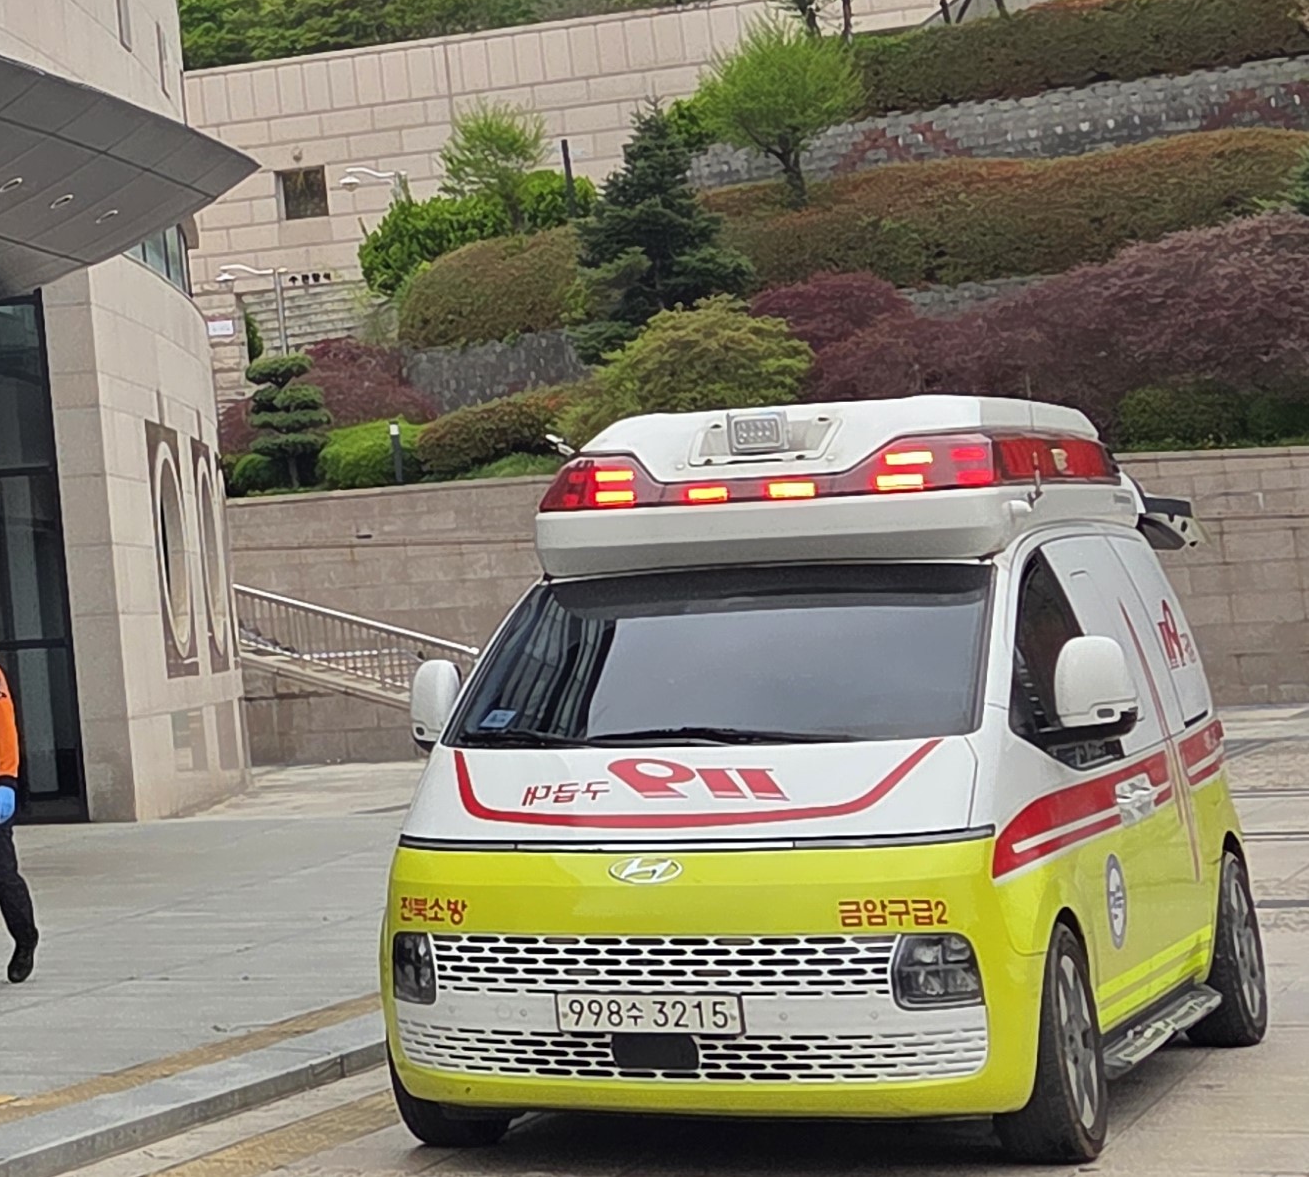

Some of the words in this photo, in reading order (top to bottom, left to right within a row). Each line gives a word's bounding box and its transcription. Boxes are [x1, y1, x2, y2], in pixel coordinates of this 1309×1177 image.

[400, 897, 468, 925] 전북소방
[838, 899, 948, 927] 금암구급2
[568, 999, 644, 1027] 998수
[652, 1000, 728, 1029] 3215
